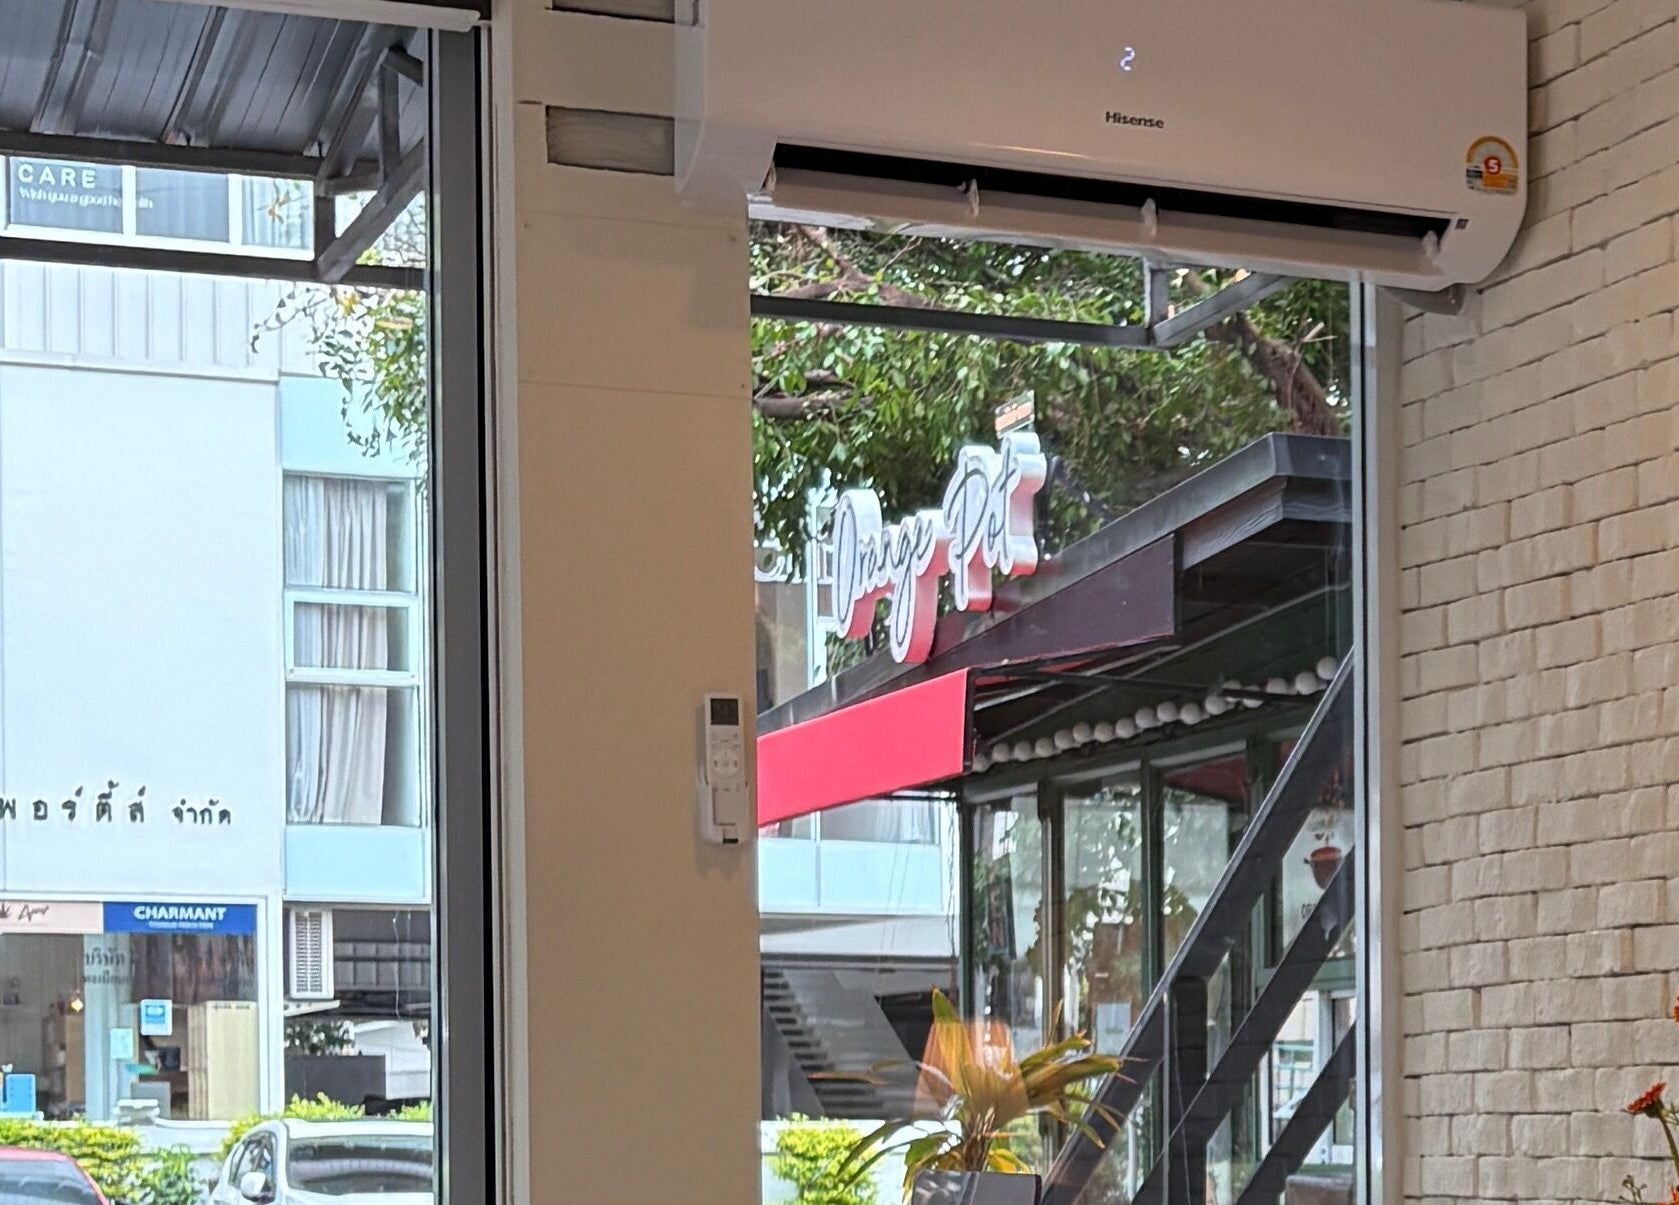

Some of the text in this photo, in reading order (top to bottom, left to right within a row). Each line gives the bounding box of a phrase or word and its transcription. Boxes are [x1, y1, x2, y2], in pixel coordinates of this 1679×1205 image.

[1105, 111, 1165, 129] Hisense
[18, 164, 96, 188] CARE
[832, 436, 1038, 662] Orange Pot
[133, 905, 227, 921] CHARMANT
